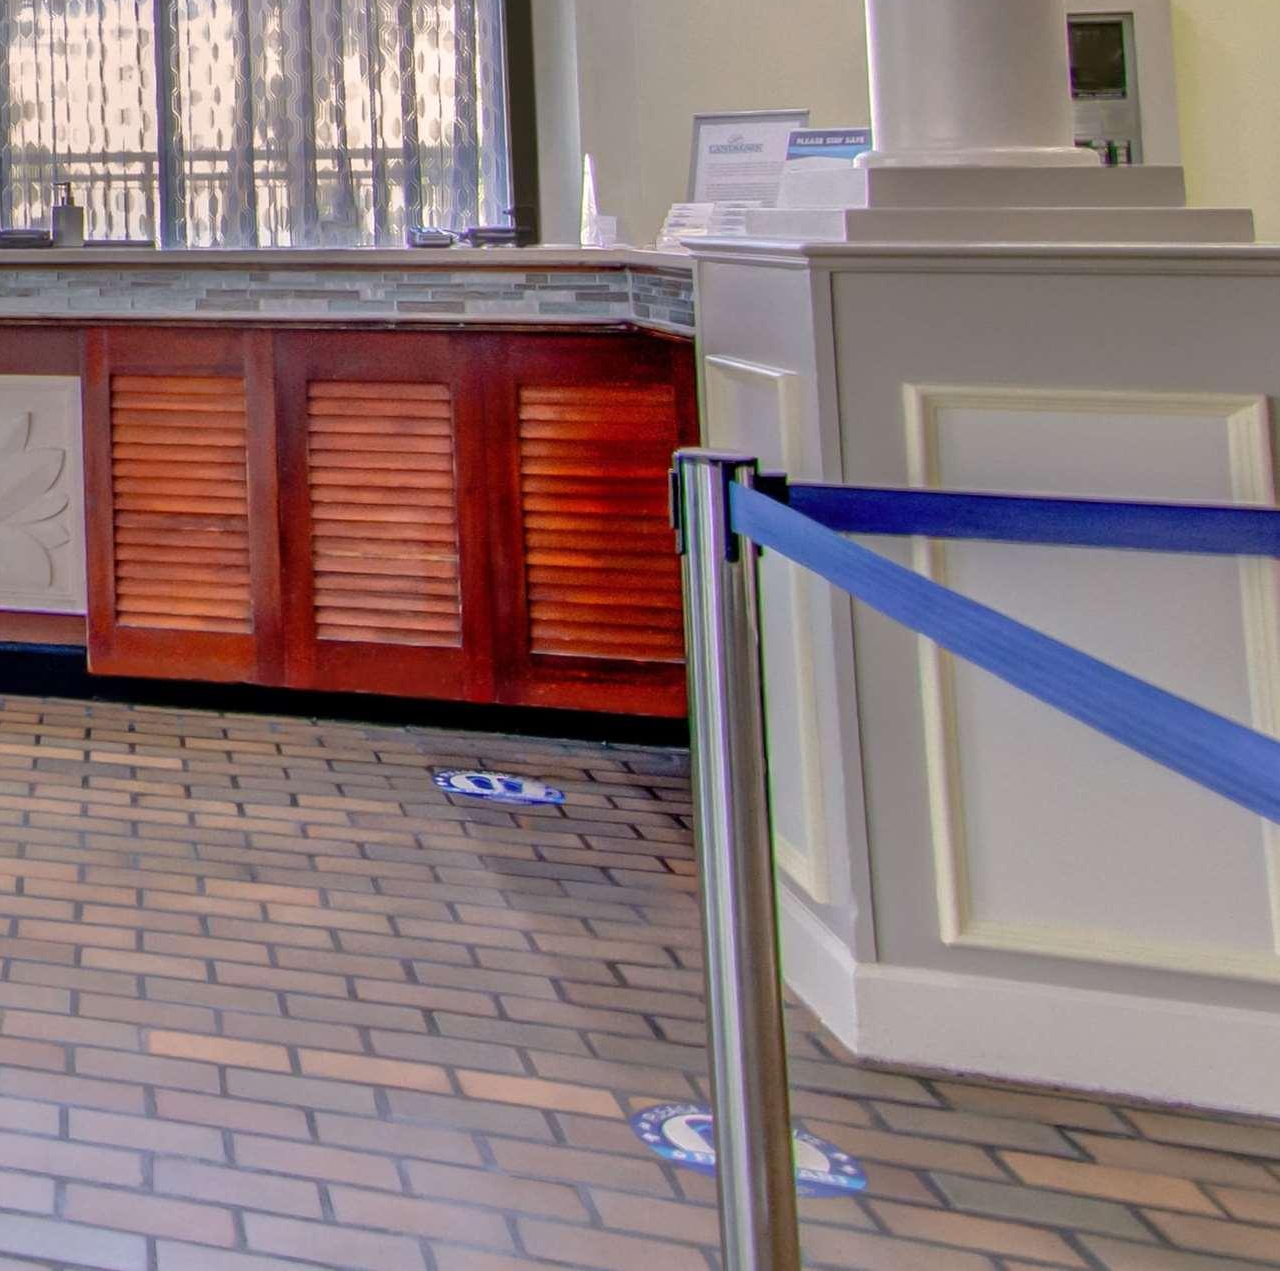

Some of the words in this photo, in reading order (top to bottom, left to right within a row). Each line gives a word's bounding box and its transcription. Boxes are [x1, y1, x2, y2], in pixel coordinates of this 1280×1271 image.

[795, 137, 823, 145] PLEASE
[825, 136, 843, 145] STAY
[845, 134, 866, 144] SAFE
